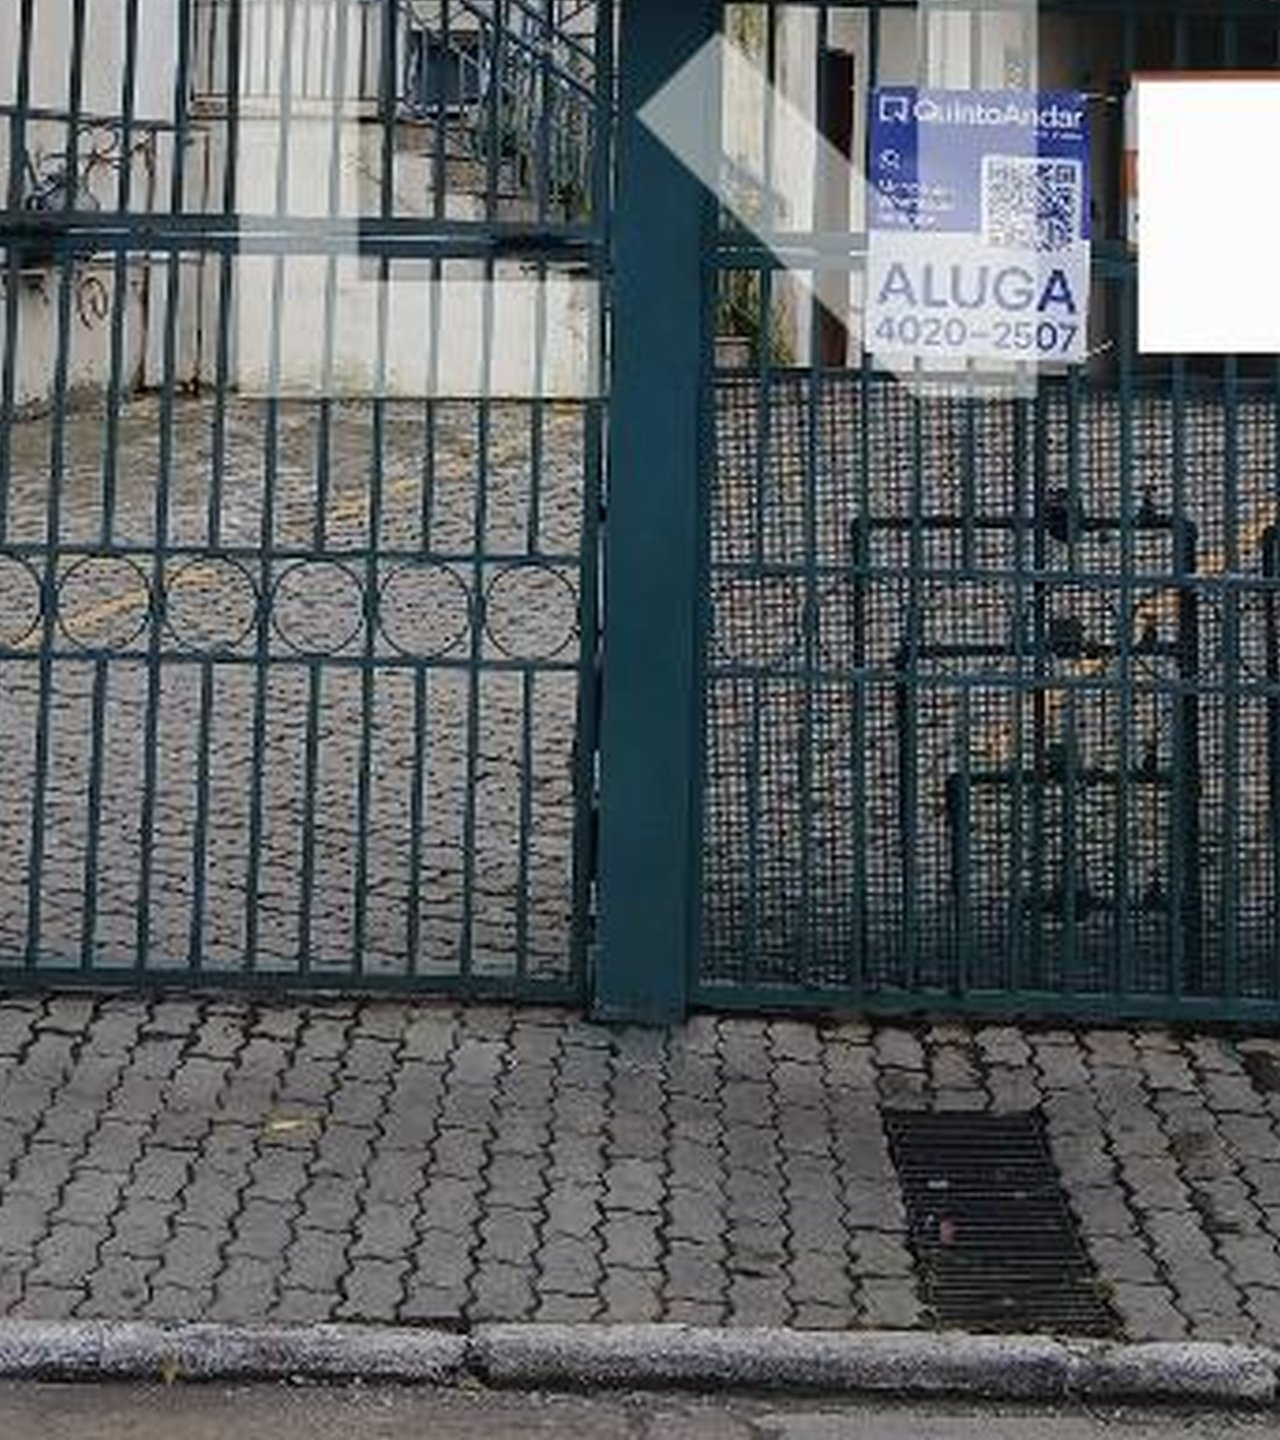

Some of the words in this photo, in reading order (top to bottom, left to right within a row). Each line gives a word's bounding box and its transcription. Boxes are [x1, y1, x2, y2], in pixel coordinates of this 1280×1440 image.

[913, 98, 1084, 128] QuintoAndar
[877, 262, 1077, 312] ALUGA
[875, 315, 1078, 353] 4020-2507
